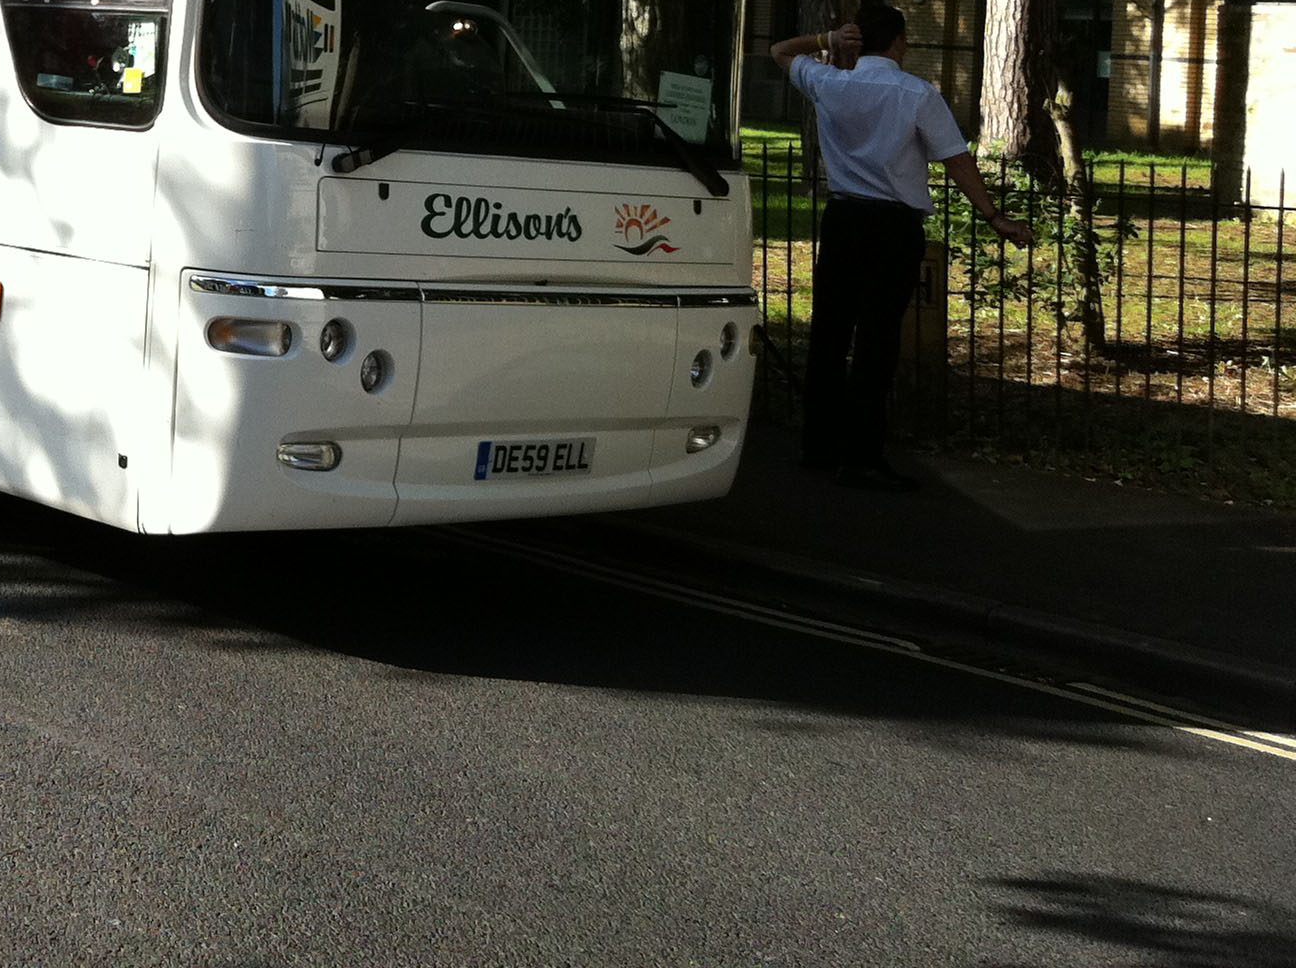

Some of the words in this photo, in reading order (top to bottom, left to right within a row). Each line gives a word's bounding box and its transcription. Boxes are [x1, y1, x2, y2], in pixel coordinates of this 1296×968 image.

[421, 193, 582, 242] Ellison's
[491, 444, 550, 473] DE59
[552, 442, 589, 471] ELL
